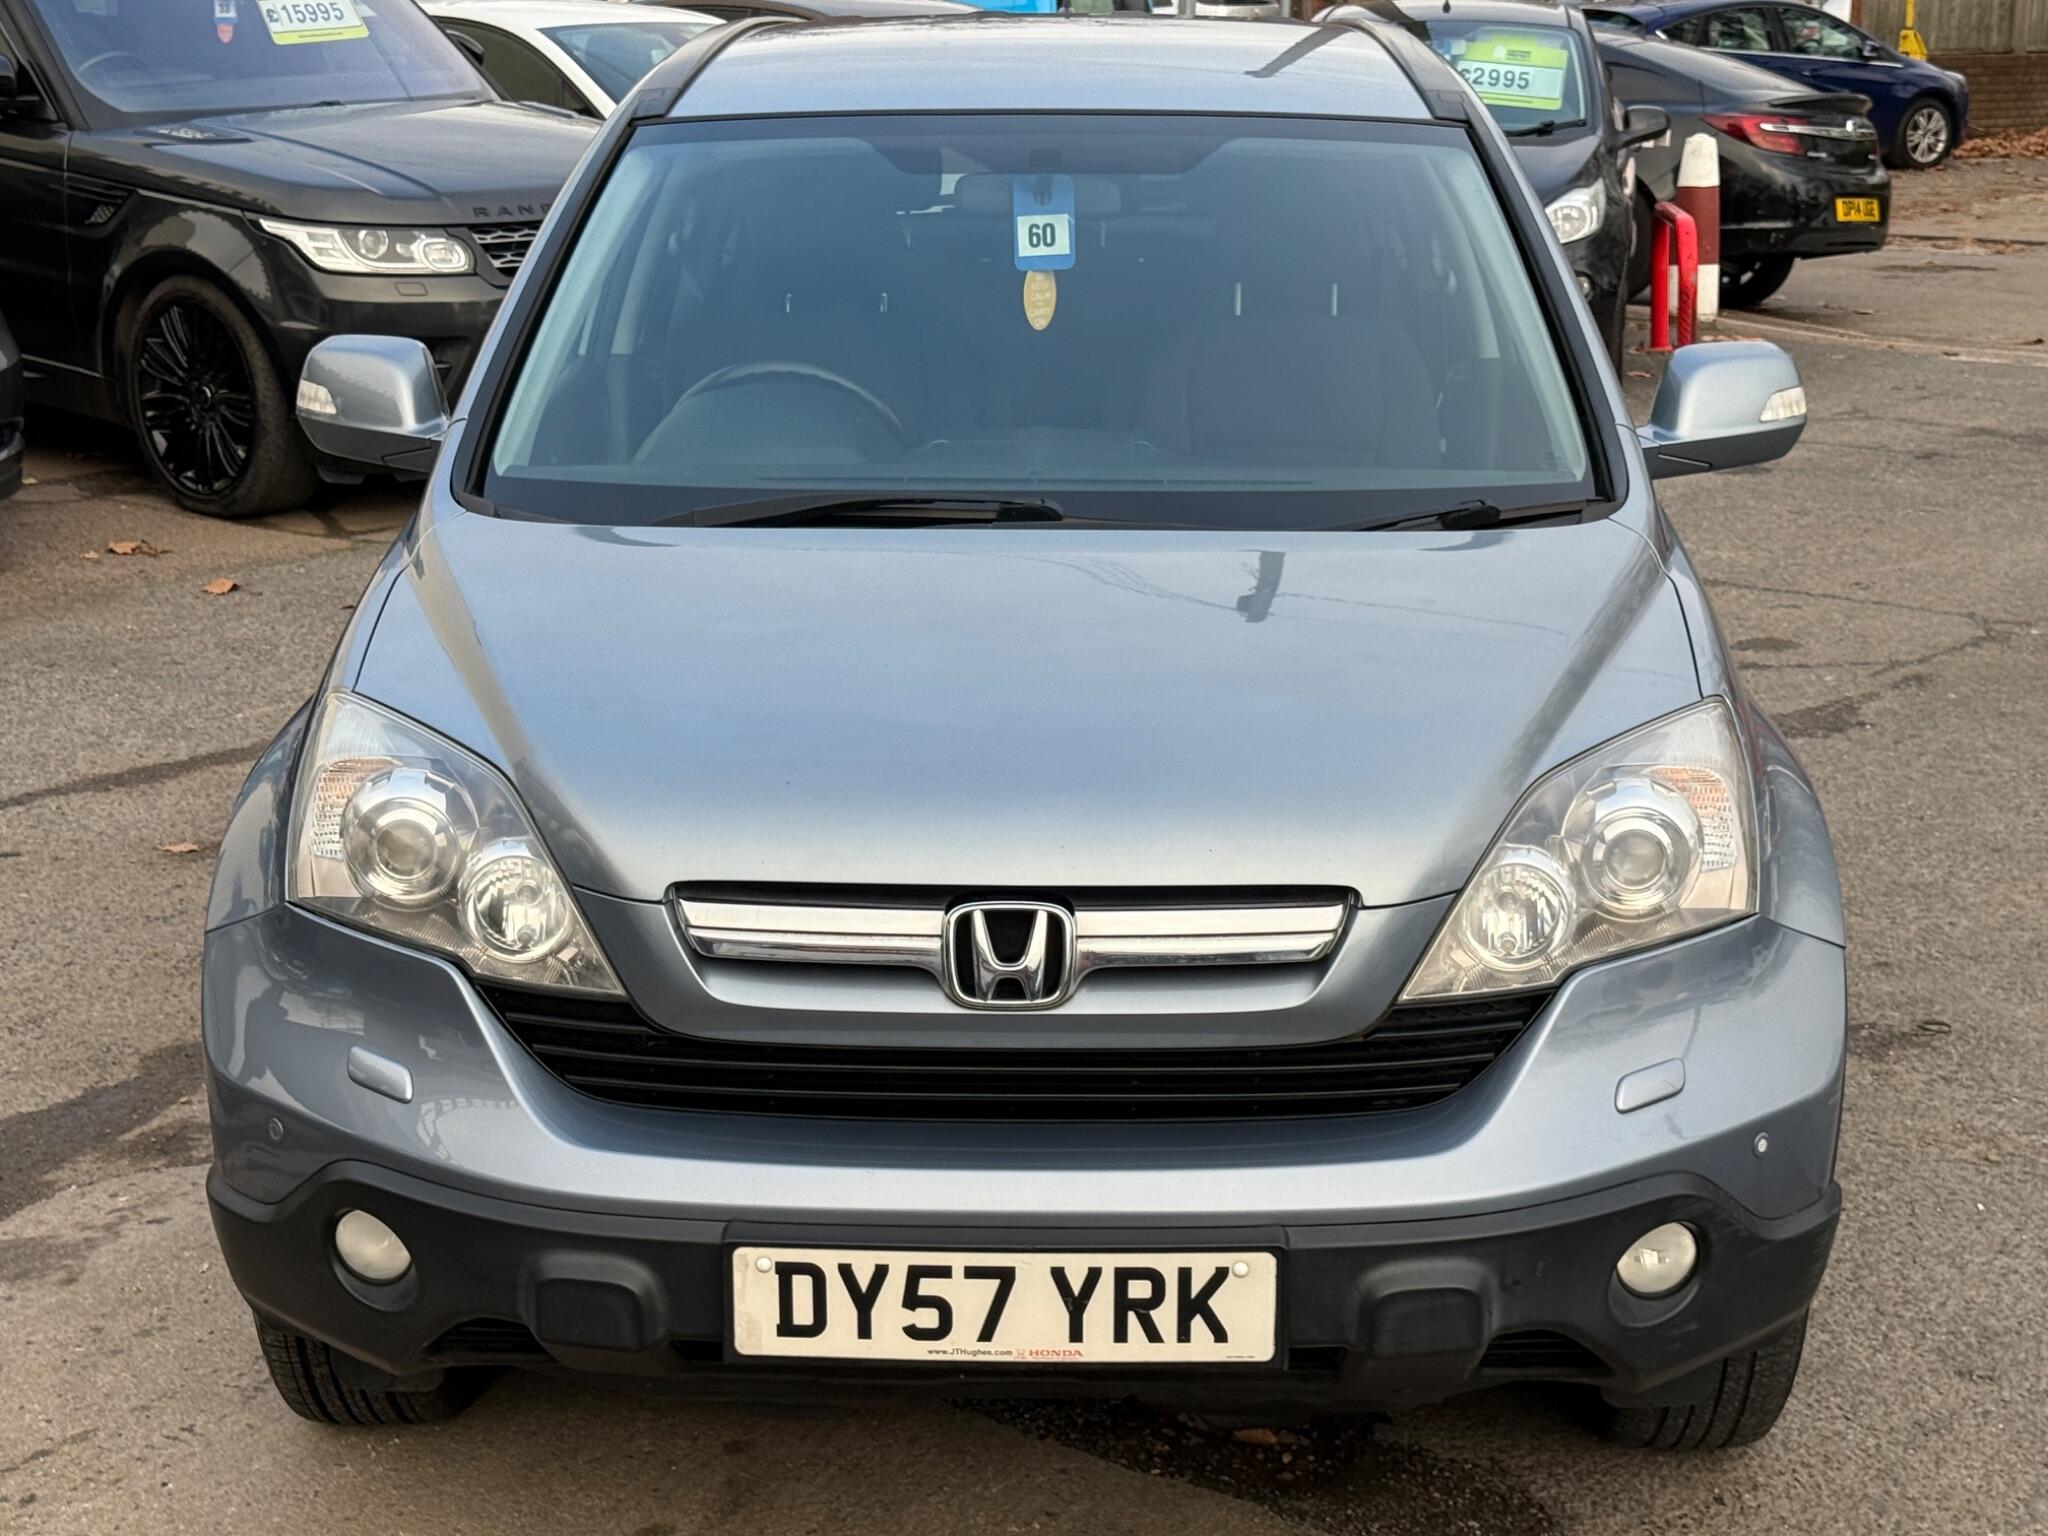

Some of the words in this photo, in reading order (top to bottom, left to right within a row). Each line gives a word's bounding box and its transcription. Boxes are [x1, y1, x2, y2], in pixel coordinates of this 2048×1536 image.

[266, 2, 344, 24] £15995
[1028, 222, 1056, 248] 60
[774, 1260, 1016, 1343] DY57
[1049, 1266, 1229, 1344] YRK
[927, 1348, 1013, 1357] www.JTHughes.com
[1029, 1349, 1084, 1358] HONDA
